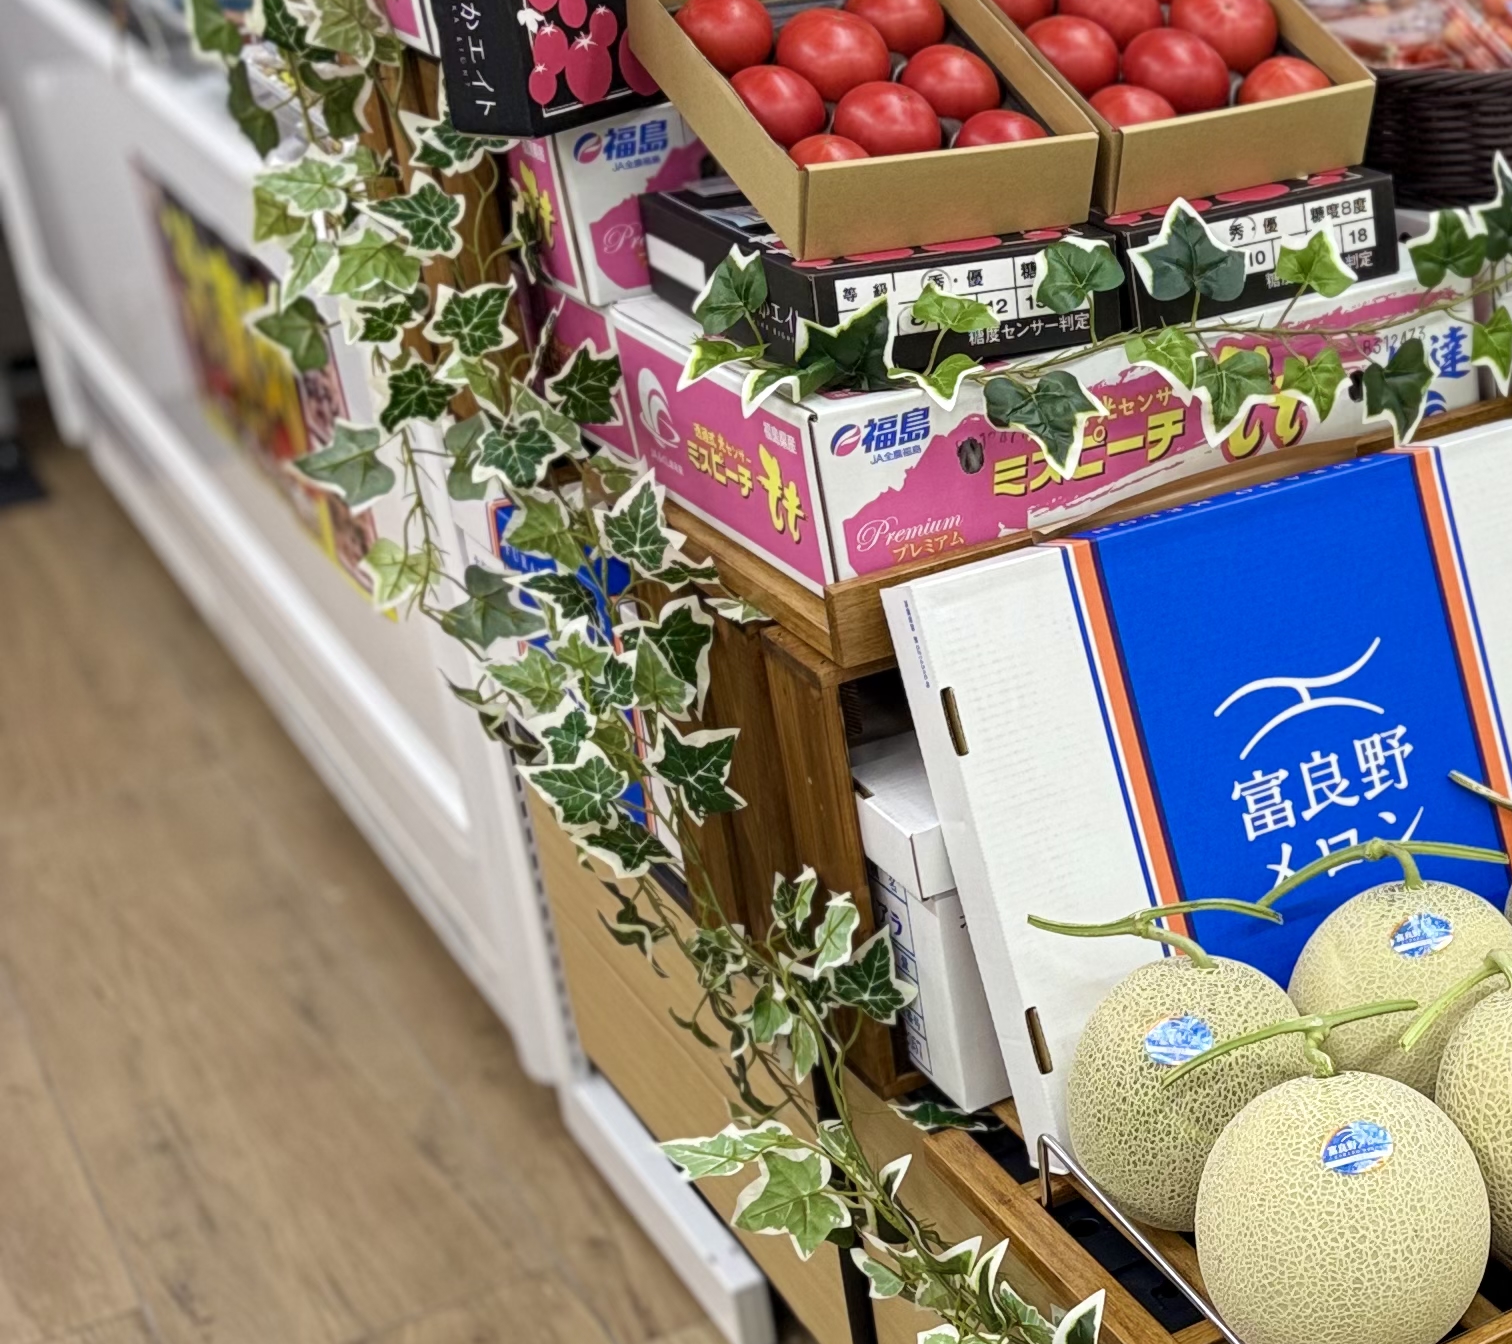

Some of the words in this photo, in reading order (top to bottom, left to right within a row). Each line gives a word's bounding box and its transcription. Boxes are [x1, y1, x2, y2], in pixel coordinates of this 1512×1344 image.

[604, 119, 668, 161] 福島
[1348, 228, 1368, 245] 18
[968, 313, 1090, 346] 糖度センサー判定
[861, 406, 931, 453] 福島
[687, 440, 754, 498] ミスピーチ
[756, 443, 808, 544] もも
[856, 510, 964, 552] Premium
[893, 531, 965, 563] プレミアム
[1231, 724, 1415, 842] 富良野
[1265, 806, 1426, 887] メロン
